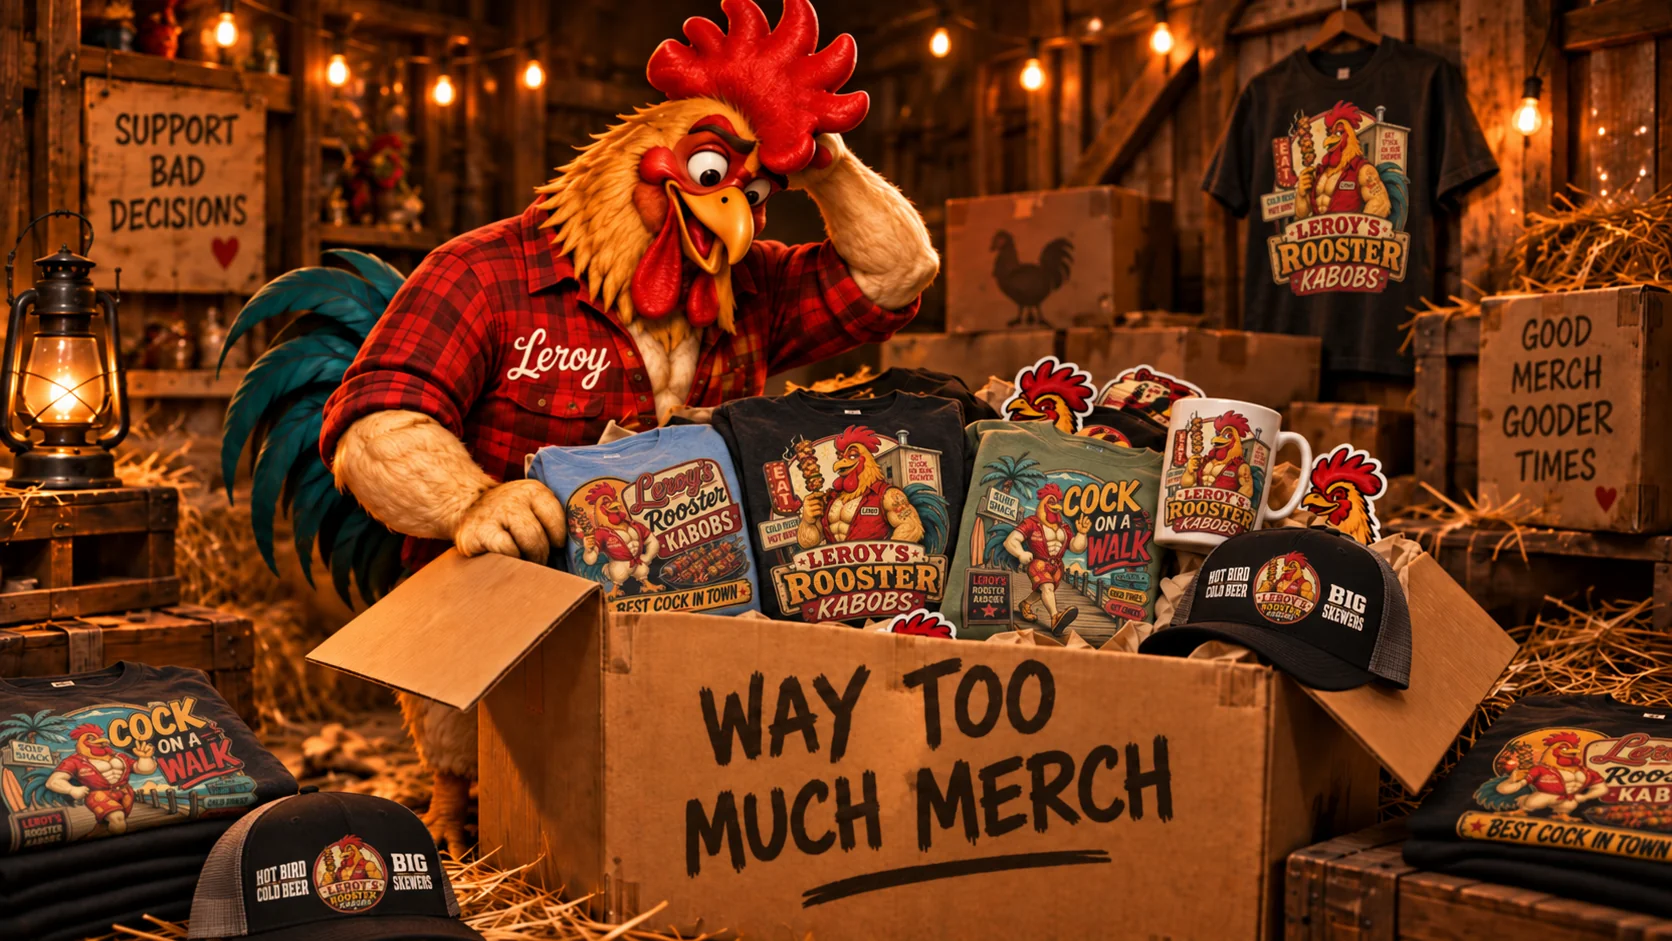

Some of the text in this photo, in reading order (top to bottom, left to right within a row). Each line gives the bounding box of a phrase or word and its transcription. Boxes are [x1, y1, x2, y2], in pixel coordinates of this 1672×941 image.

[115, 112, 238, 146] SUPPORT
[150, 154, 205, 188] BAD
[1279, 142, 1290, 180] EAT
[109, 194, 247, 232] DECISIONS
[1295, 215, 1381, 240] LEROY'S
[1278, 237, 1401, 275] ROOSTER
[1300, 265, 1380, 292] KABOBS
[1521, 315, 1592, 351] GOOD
[507, 328, 611, 390] Leroy
[1512, 354, 1602, 394] MERCH
[1502, 400, 1613, 438] GOODER
[1515, 447, 1596, 482] TIMES
[630, 459, 714, 515] Leroy's
[773, 466, 790, 506] EAT
[1063, 479, 1141, 517] COCK
[1184, 488, 1246, 507] LEROY'S
[643, 486, 727, 532] Rooster
[1095, 514, 1130, 532] ON A
[1168, 501, 1254, 529] ROOSTER
[1180, 516, 1239, 535] KABOBS
[665, 510, 733, 552] KABOBS
[808, 543, 910, 569] LEROY'S
[1088, 530, 1152, 567] WALK
[784, 564, 938, 605] ROOSTER
[1205, 583, 1248, 598] COLD BEER
[1208, 566, 1250, 585] HOT BIRD
[653, 593, 690, 612] COCK
[692, 591, 704, 606] IN
[706, 584, 738, 604] TOWN
[817, 591, 913, 620] KABOBS
[1328, 583, 1367, 614] BIG
[1322, 603, 1365, 632] SKEWERS
[108, 697, 207, 747] COCK
[699, 657, 1056, 766] WAY TOO
[157, 732, 201, 754] ON A
[157, 738, 241, 783] WALK
[685, 733, 1174, 879] MUCH MERCH
[1486, 818, 1671, 859] BEST COCK IN TOWN
[256, 860, 307, 886] HOT BIRD
[390, 852, 428, 872] BIG
[256, 879, 310, 902] COLD BEER
[393, 874, 433, 891] SKEWERS
